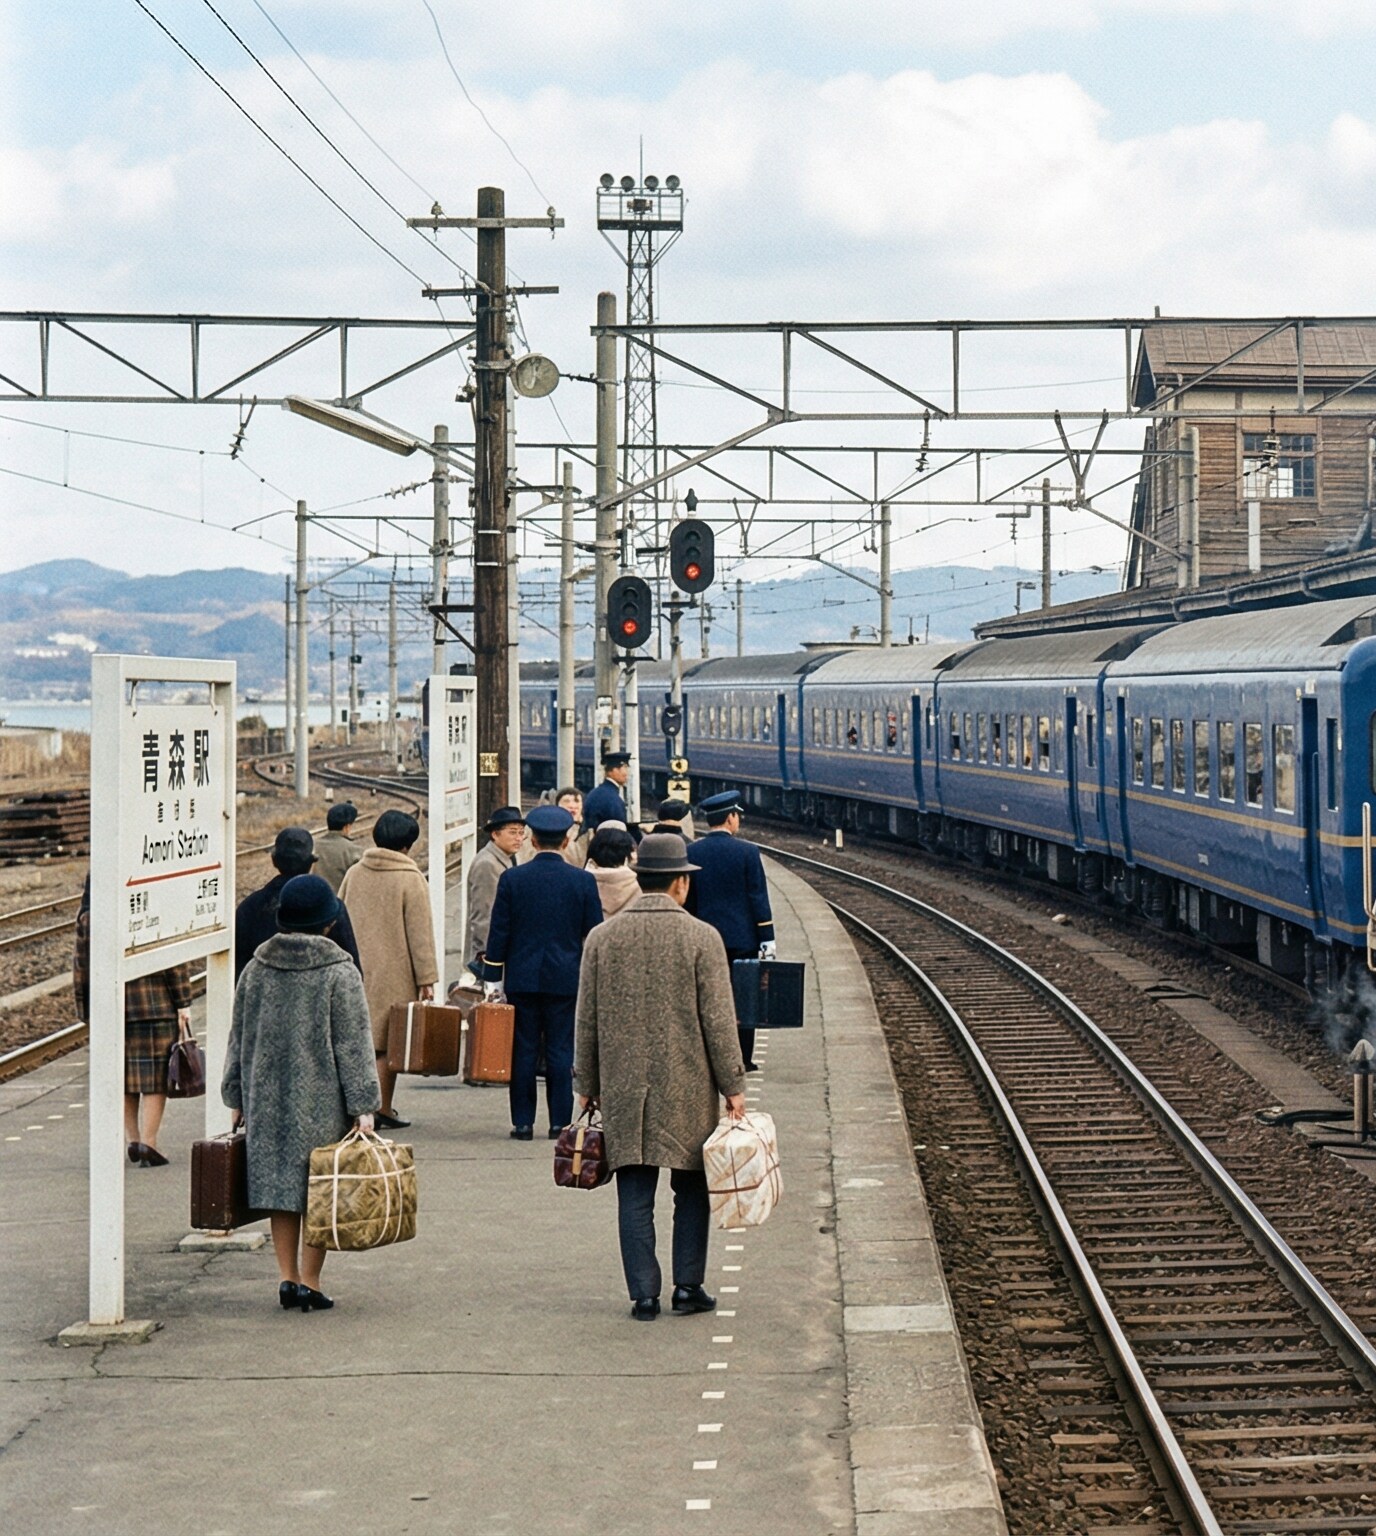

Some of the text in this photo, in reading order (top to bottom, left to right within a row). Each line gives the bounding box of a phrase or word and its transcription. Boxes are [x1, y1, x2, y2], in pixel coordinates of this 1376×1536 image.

[142, 729, 209, 793] 青森駅
[142, 827, 209, 865] Aomori Station
